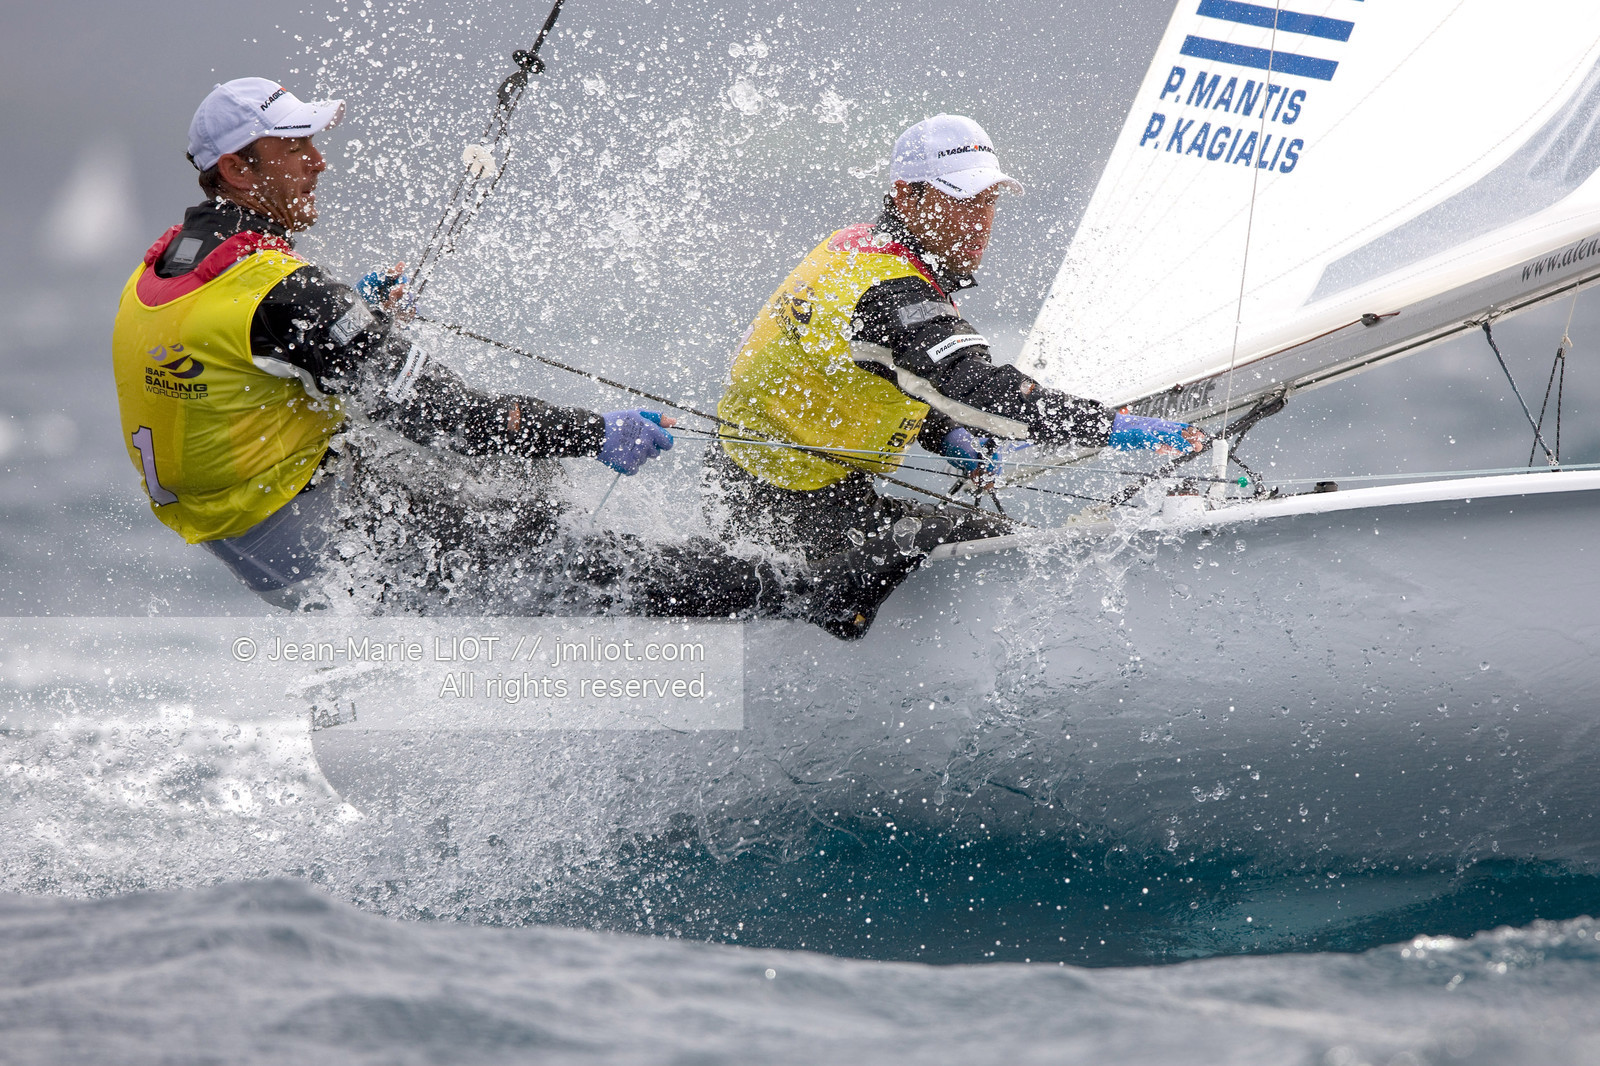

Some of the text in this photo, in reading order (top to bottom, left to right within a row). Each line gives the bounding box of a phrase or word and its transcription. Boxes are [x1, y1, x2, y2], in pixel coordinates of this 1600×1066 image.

[1159, 65, 1307, 125] P.MANTIS
[1139, 112, 1304, 174] P.KAGIALIS
[935, 340, 957, 356] MAGIC
[145, 366, 166, 378] ISAF
[144, 384, 209, 400] WORLDCUP
[145, 375, 208, 393] SAILING
[131, 425, 180, 508] 1
